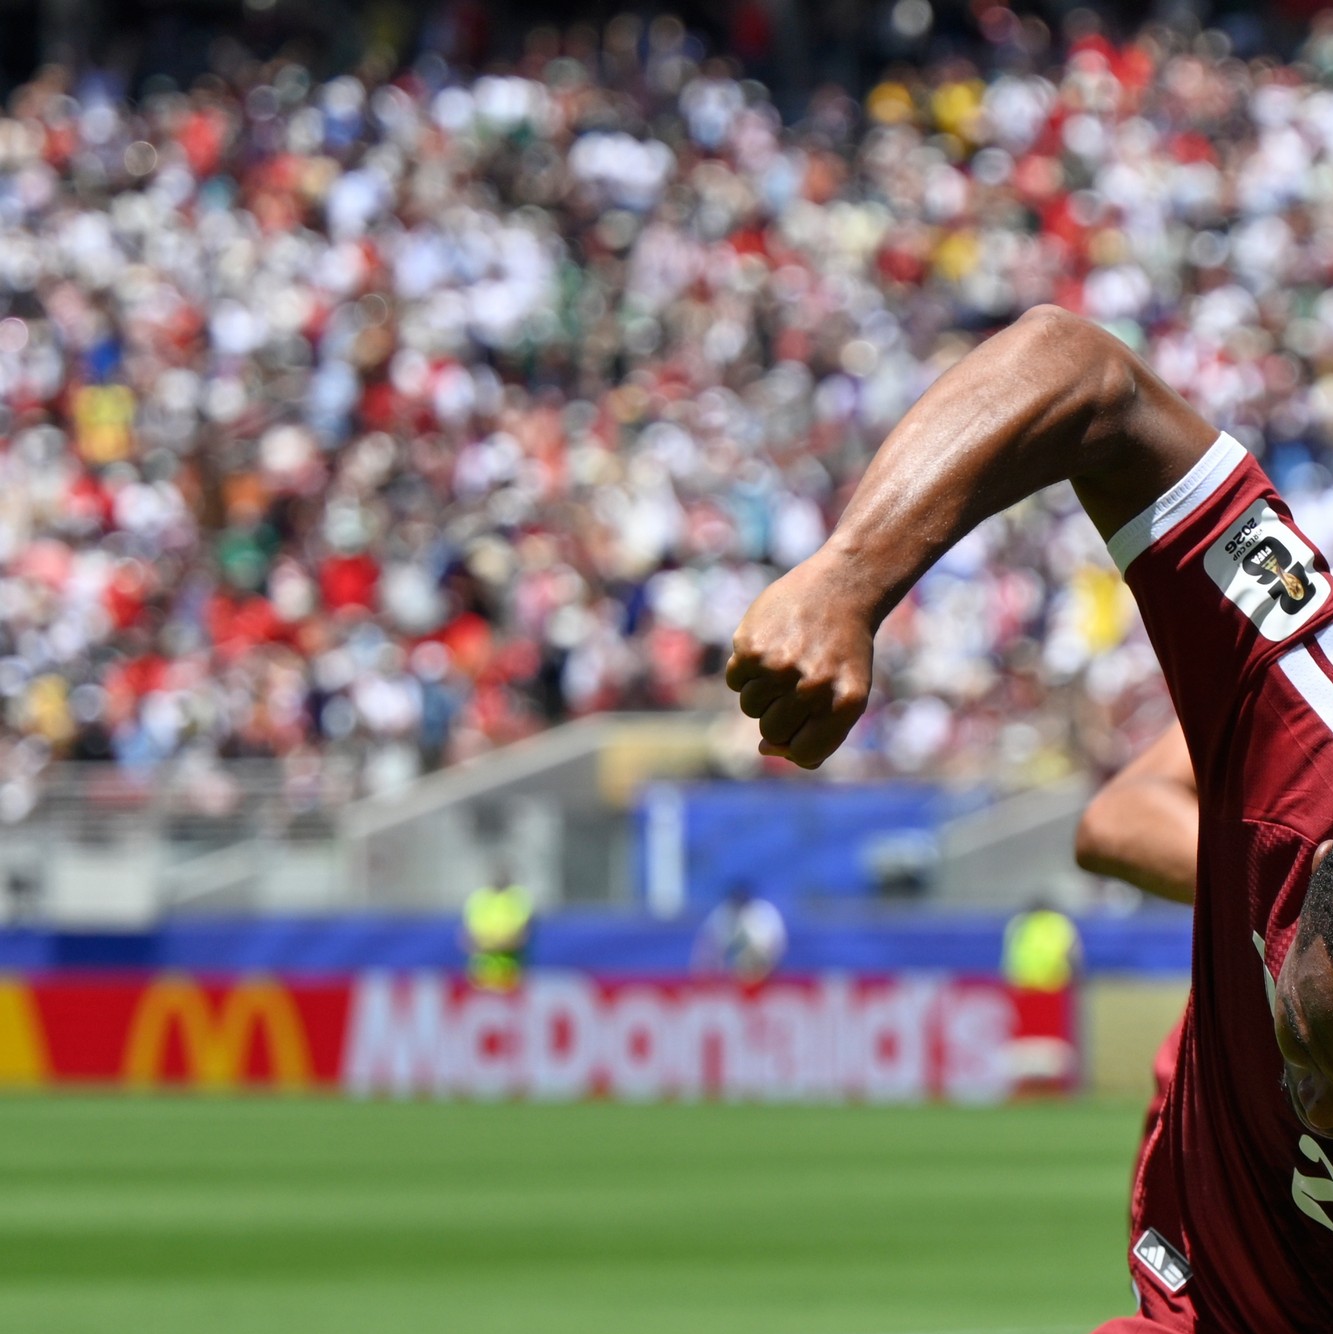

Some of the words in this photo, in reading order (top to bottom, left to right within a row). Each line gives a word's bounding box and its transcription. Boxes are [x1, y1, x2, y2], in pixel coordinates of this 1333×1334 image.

[1224, 517, 1258, 555] 2026
[1244, 528, 1263, 550] RLD
[1232, 546, 1248, 562] CUP
[1251, 545, 1273, 565] FIFA
[337, 970, 1020, 1101] McDonald's
